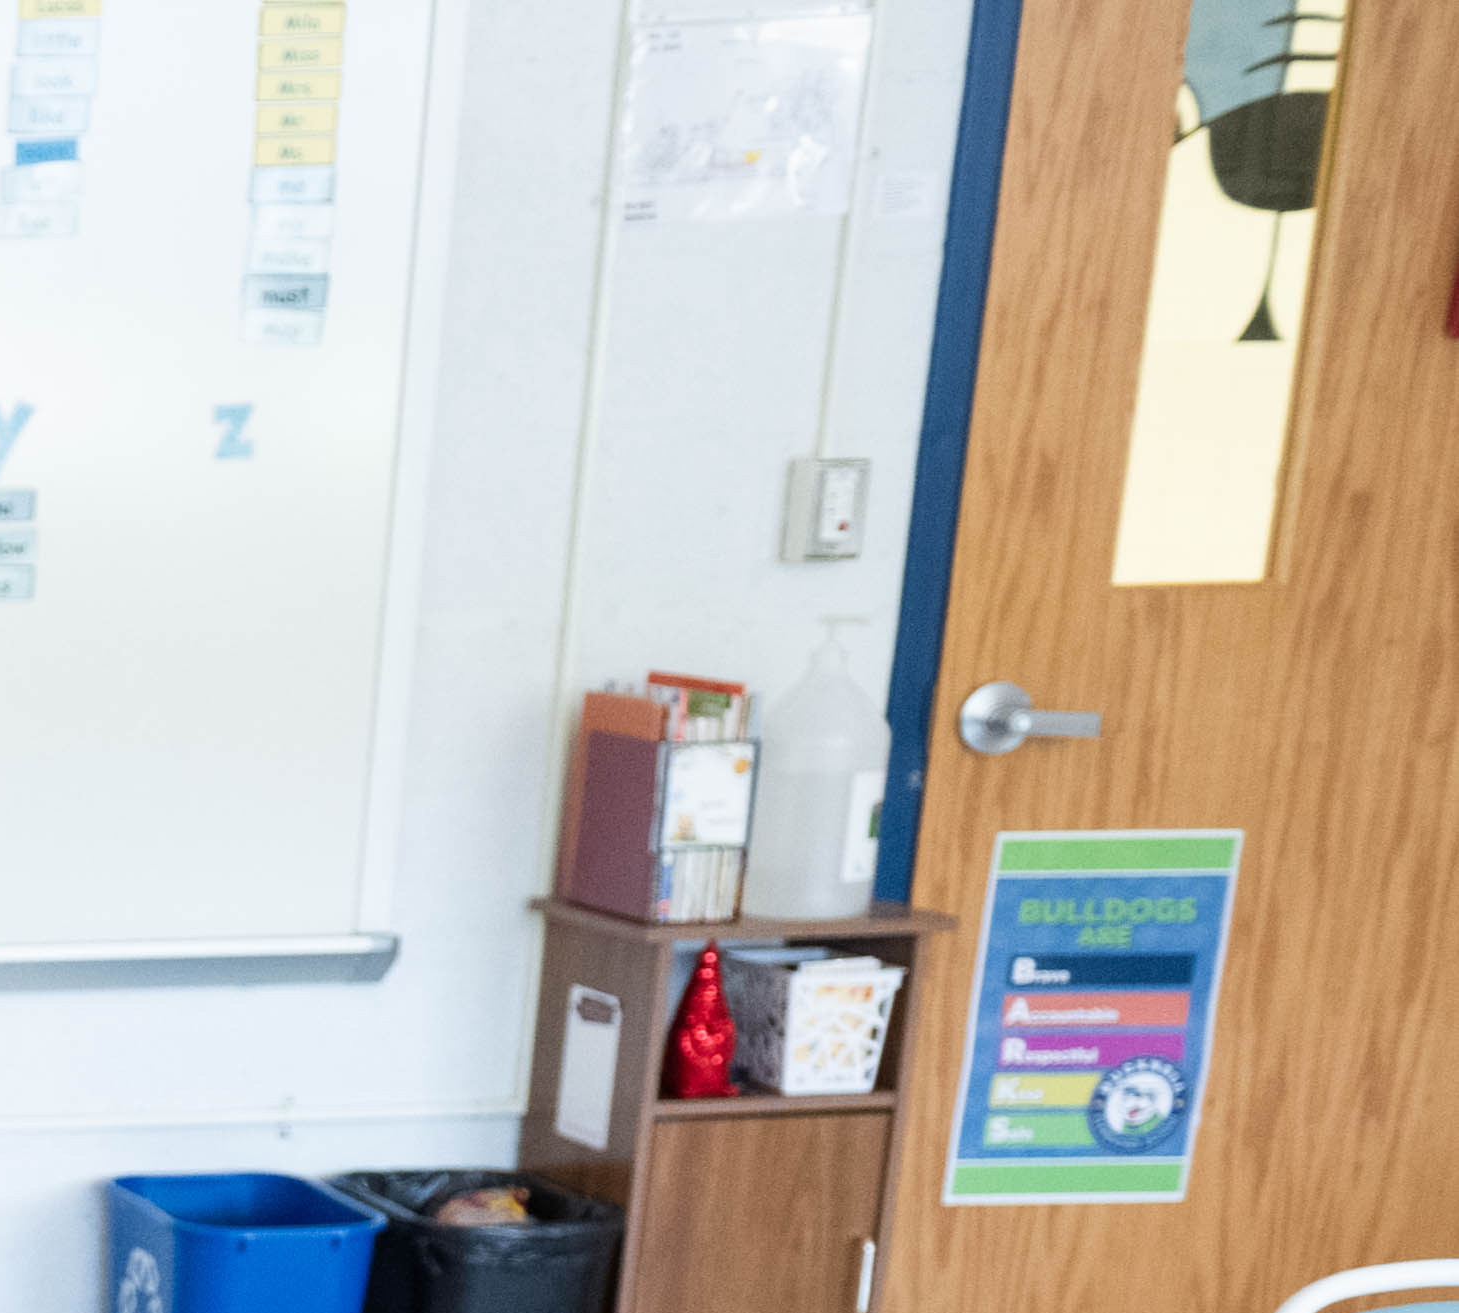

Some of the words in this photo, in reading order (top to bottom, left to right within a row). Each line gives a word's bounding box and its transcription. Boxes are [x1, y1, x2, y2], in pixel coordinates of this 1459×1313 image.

[213, 403, 253, 461] z
[1018, 896, 1199, 925] BULLDOGS
[1077, 925, 1134, 948] ARE
